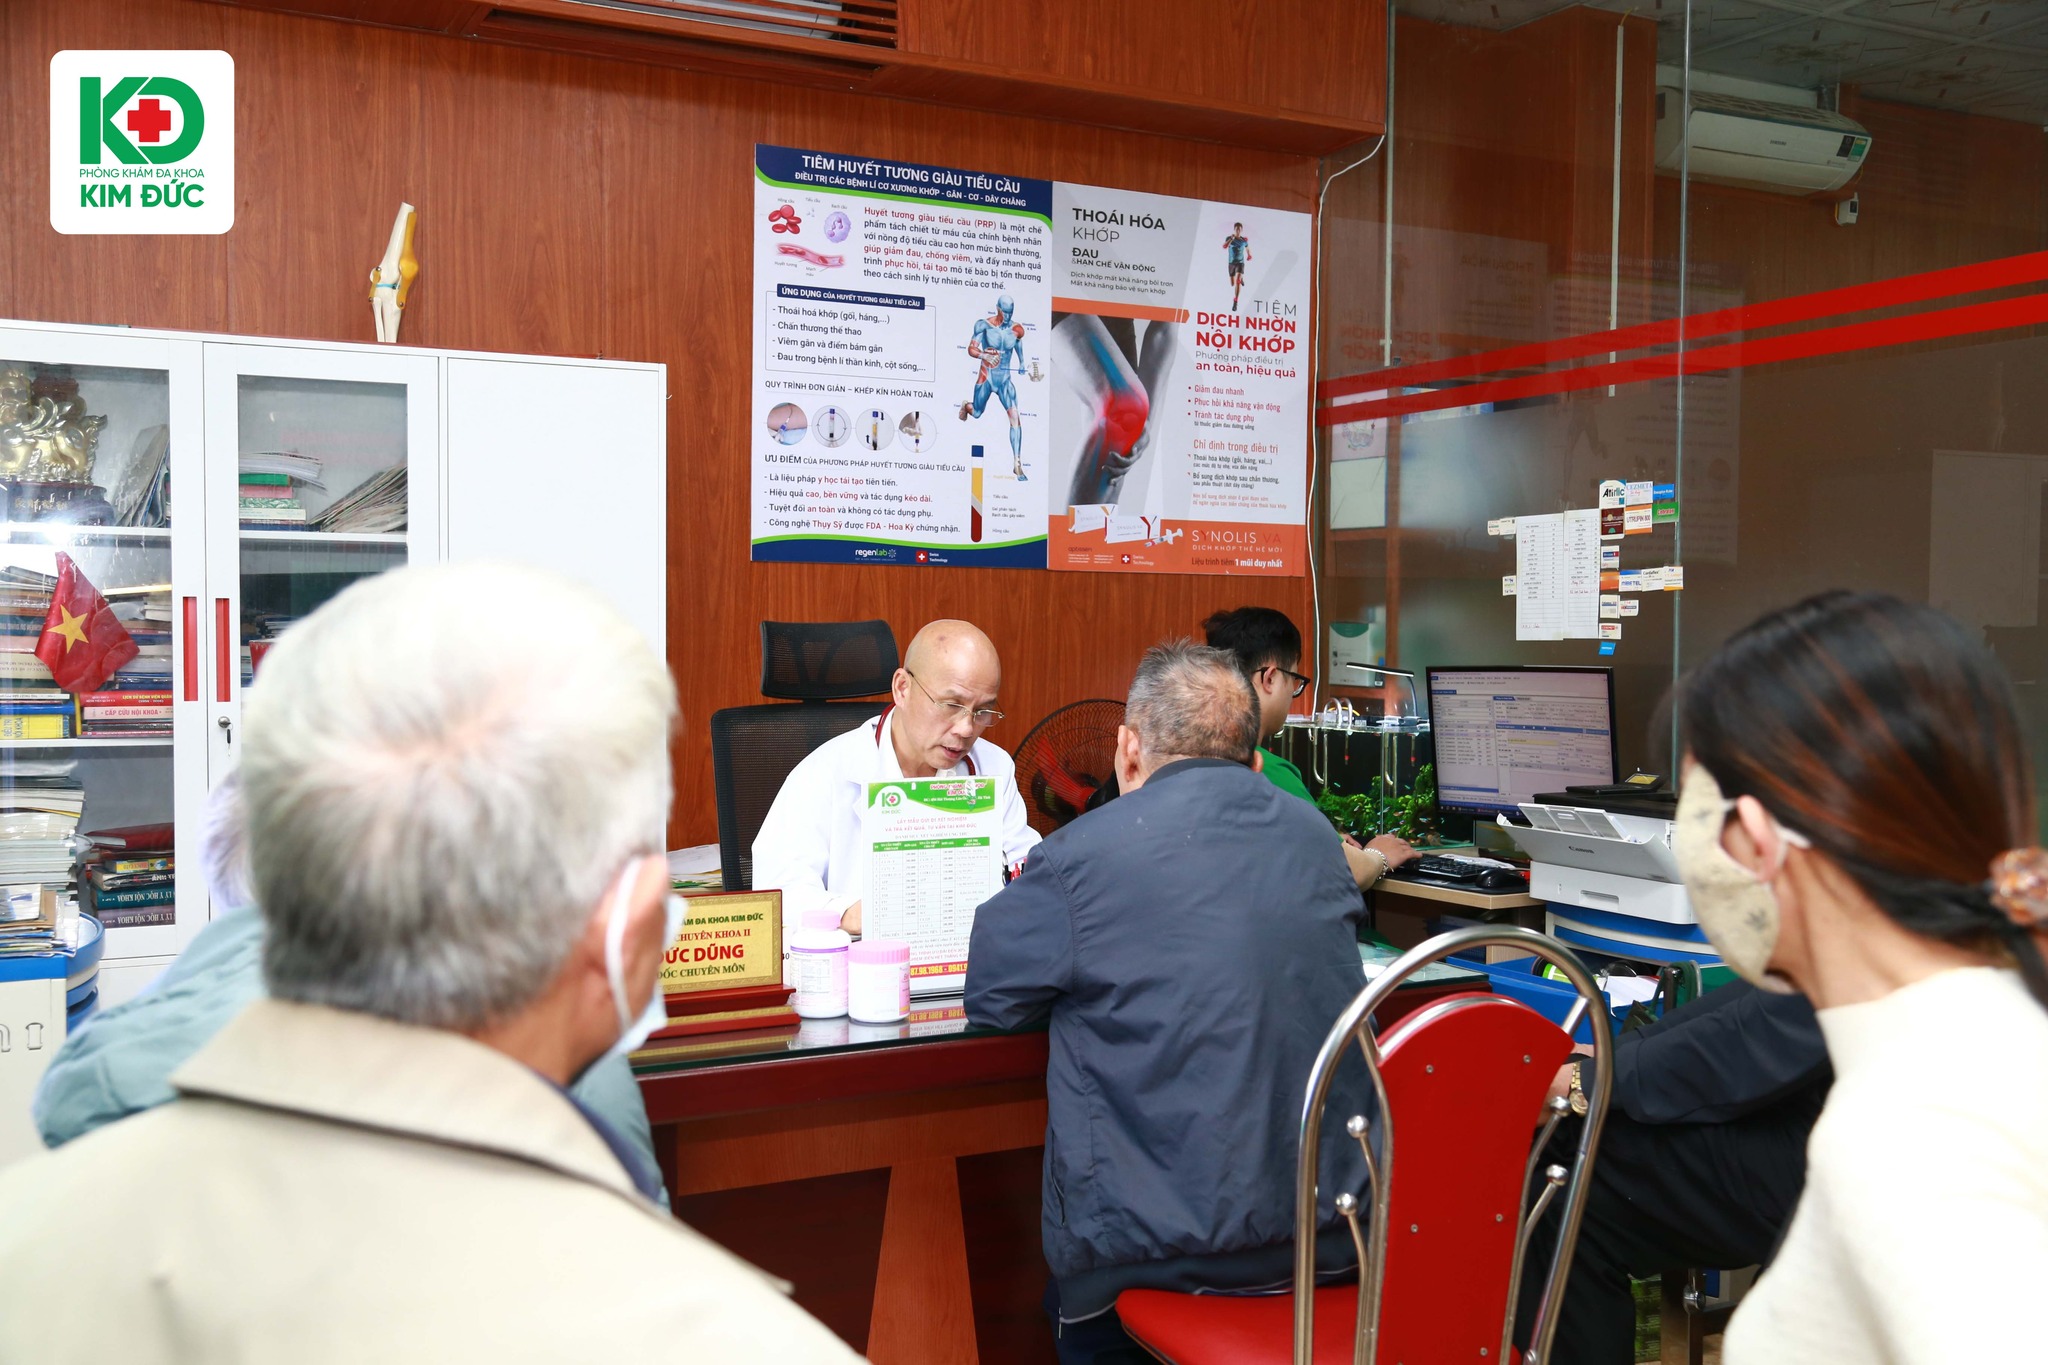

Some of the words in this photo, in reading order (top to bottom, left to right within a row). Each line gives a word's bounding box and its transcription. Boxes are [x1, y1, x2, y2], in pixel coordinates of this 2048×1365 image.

[802, 154, 834, 170] TIÊM
[838, 159, 881, 175] HUYẾT
[883, 165, 928, 181] TƯƠNG
[932, 171, 961, 186] GIÀU
[965, 174, 991, 189] TIỂU
[995, 177, 1019, 193] CẦU
[794, 170, 813, 180] ĐIỀU
[814, 174, 827, 184] TRỊ
[829, 175, 845, 184] CÁC
[846, 177, 867, 187] BỆNH
[869, 179, 876, 188] LÍ
[890, 183, 917, 193] XƯƠNG
[919, 187, 939, 195] KHỚP
[946, 189, 961, 198] GÂN
[985, 194, 999, 203] DÂY
[1000, 197, 1025, 206] CHẰNG
[864, 207, 887, 217] Huyết
[891, 210, 914, 221] tương
[918, 213, 935, 222] giàu
[938, 215, 953, 224] tiểu
[974, 219, 996, 229] (PRP)
[999, 222, 1006, 230] là
[1010, 223, 1024, 233] một
[1028, 225, 1042, 234] chế
[1072, 207, 1123, 225] THOÁI
[1129, 213, 1165, 230] HÓA
[1073, 226, 1119, 242] KHỚP
[1072, 247, 1098, 258] ĐAU
[1132, 264, 1155, 272] ĐỘNG
[777, 305, 800, 314] Thoái
[801, 307, 816, 316] hoá
[818, 309, 838, 319] khớp
[840, 311, 856, 321] (gối,
[858, 312, 890, 324] háng,...)
[1253, 299, 1296, 316] TIÊM
[777, 321, 798, 330] Chấn
[799, 323, 828, 334] thương
[830, 325, 843, 334] thể
[844, 326, 861, 335] thao
[1197, 311, 1239, 330] DỊCH
[1245, 316, 1295, 333] NHỜN
[777, 336, 798, 345] Viêm
[799, 338, 814, 348] gân
[827, 340, 847, 349] điểm
[849, 342, 866, 351] bám
[868, 344, 882, 353] gân
[1196, 329, 1231, 351] NỘI
[1239, 334, 1295, 353] KHỚP
[777, 352, 793, 360] Đau
[795, 354, 815, 364] trong
[817, 355, 837, 364] bệnh
[839, 356, 843, 364] lí
[845, 357, 862, 366] thần
[864, 358, 882, 368] kinh,
[884, 360, 896, 370] cột
[898, 363, 925, 372] sống,...
[1195, 351, 1230, 362] Phương
[1231, 354, 1252, 363] pháp
[1254, 356, 1272, 364] điều
[1195, 362, 1210, 370] an
[1213, 362, 1242, 374] toàn,
[1246, 364, 1271, 377] hiệu
[1274, 367, 1295, 378] quả
[765, 380, 781, 388] QUY
[783, 381, 806, 389] TRÌNH
[826, 384, 845, 392] GIẢN
[854, 386, 874, 394] KHÉP
[875, 387, 888, 395] KÍN
[913, 390, 933, 398] TOÀN
[1194, 383, 1210, 393] Giảm
[1212, 385, 1223, 394] đau
[1225, 387, 1244, 396] nhanh
[1193, 438, 1206, 449] Chỉ
[1208, 440, 1225, 452] định
[1227, 441, 1248, 454] trong
[1250, 441, 1267, 453] điều
[1269, 444, 1278, 455] trị
[769, 518, 789, 528] Công
[791, 519, 810, 528] nghệ
[812, 519, 831, 529] Thụy
[833, 520, 842, 529] Sỹ
[844, 521, 863, 529] được
[865, 521, 881, 529] FDA
[888, 522, 903, 530] Hoa
[904, 523, 914, 532] Kỳ
[915, 523, 938, 533] chứng
[940, 524, 960, 533] nhận.
[1191, 529, 1256, 543] SYNOLIS
[855, 549, 887, 557] regenlab
[1234, 558, 1238, 566] 1
[1240, 557, 1253, 566] mũi
[1253, 558, 1266, 568] duy
[1267, 558, 1282, 567] nhất
[118, 708, 130, 716] CỨU
[708, 916, 729, 924] KHOA
[731, 914, 746, 923] KIM
[747, 912, 764, 921] ĐỨC
[714, 929, 741, 939] KHOA
[743, 928, 751, 936] II
[693, 943, 744, 962] DŨNG
[680, 964, 721, 978] CHUYÊN
[722, 963, 745, 974] MÔN
